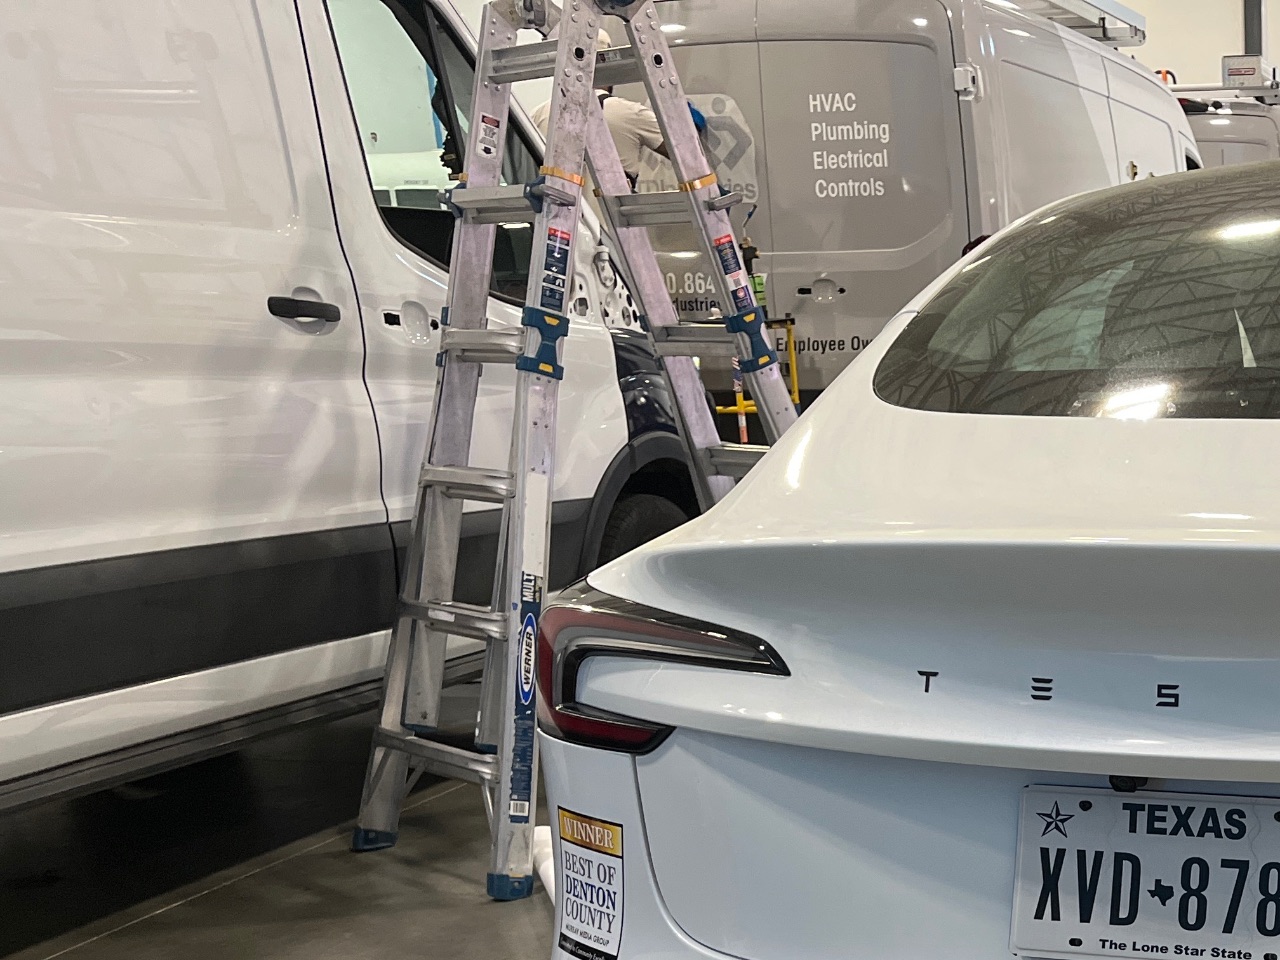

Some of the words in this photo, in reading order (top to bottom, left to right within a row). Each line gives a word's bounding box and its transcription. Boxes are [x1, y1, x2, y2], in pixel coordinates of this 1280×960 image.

[808, 92, 857, 113] HVAC
[810, 120, 890, 144] Plumbing
[812, 148, 889, 170] Electrical
[815, 178, 885, 198] Controls
[523, 631, 534, 686] WERNER
[563, 816, 614, 849] WINNER
[1121, 801, 1248, 841] TEXAS
[564, 850, 594, 880] BEST
[596, 862, 617, 886] OF
[565, 873, 618, 912] DENTON
[565, 897, 617, 934] COUNTY
[593, 935, 610, 947] GROUP
[1099, 938, 1127, 951] The
[1132, 940, 1169, 954] Lone
[1173, 944, 1207, 957] Star
[1210, 946, 1253, 960] State
